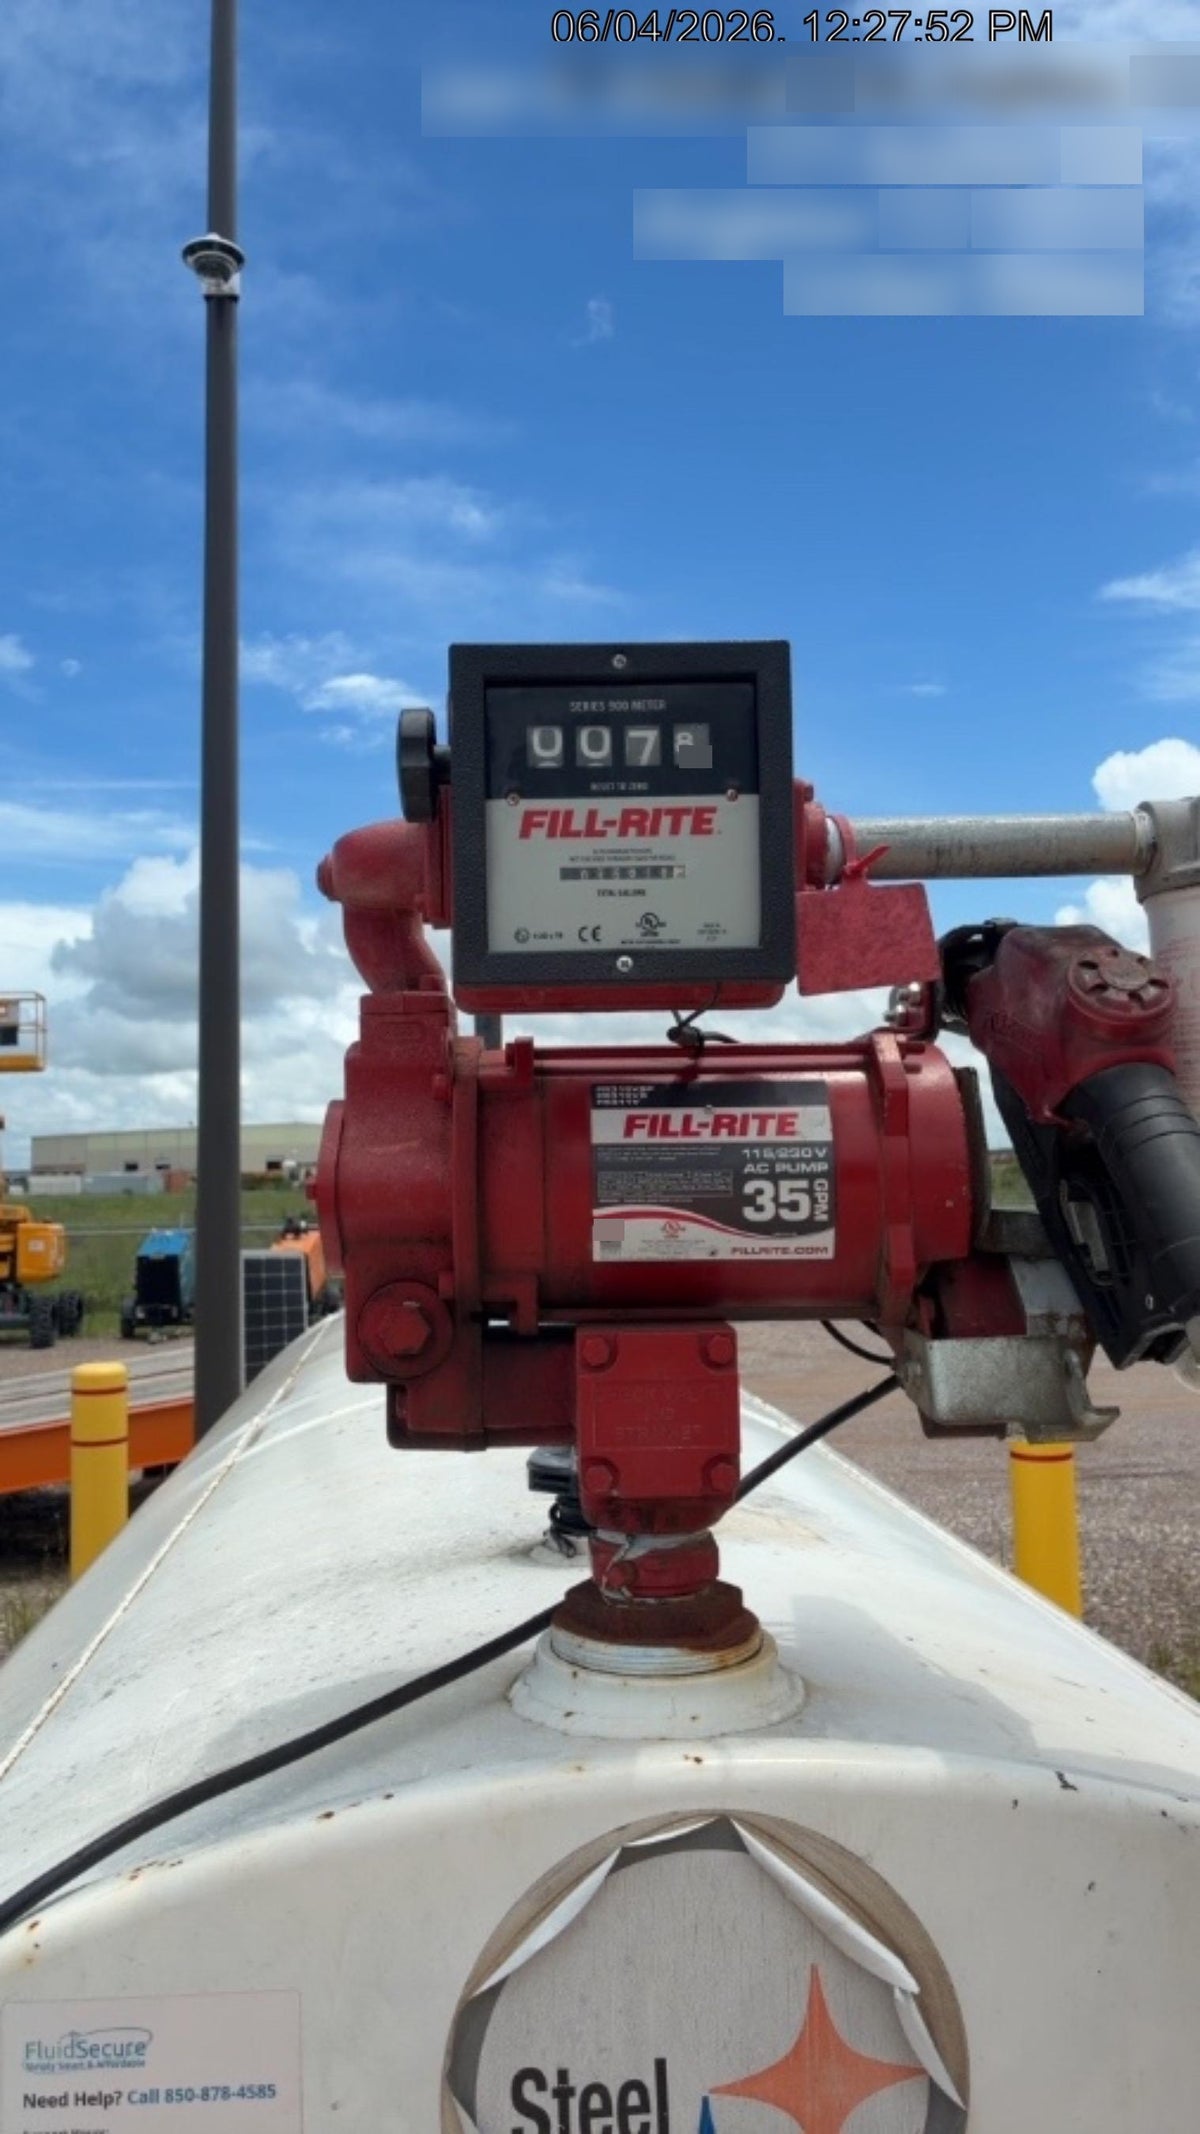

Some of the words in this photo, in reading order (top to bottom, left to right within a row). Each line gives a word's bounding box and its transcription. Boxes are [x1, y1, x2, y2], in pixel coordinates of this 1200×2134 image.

[518, 806, 717, 839] FILL-RITE
[623, 1113, 799, 1138] FILL-RITE
[744, 1163, 769, 1174] AC
[775, 1162, 829, 1173] PUMP
[742, 1178, 811, 1222] 35
[813, 1178, 829, 1222] GPM
[730, 1246, 828, 1255] FILLRITE.COM
[25, 2036, 146, 2059] FluidSecure
[23, 2091, 69, 2108] Need
[74, 2090, 123, 2110] Help?
[127, 2088, 160, 2105] Call
[165, 2084, 277, 2104] 850-878-4585
[510, 2057, 669, 2134] Steel
